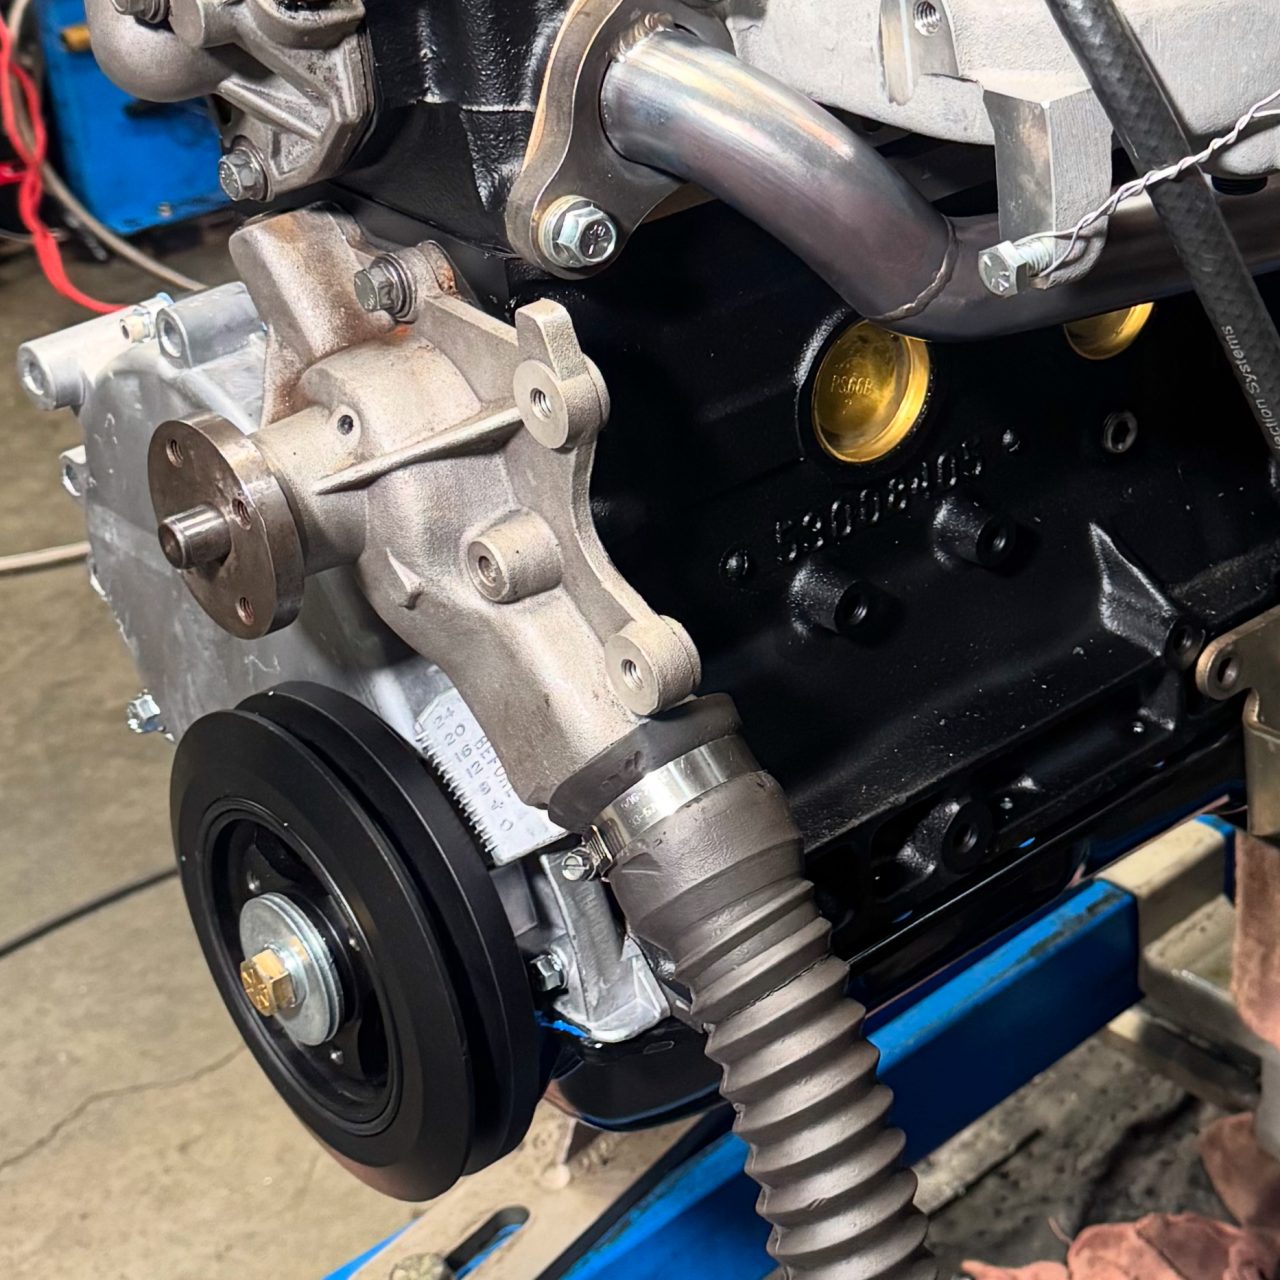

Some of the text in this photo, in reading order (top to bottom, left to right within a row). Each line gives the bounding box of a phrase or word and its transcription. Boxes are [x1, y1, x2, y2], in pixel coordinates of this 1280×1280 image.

[1221, 325, 1260, 394] Systems
[444, 723, 466, 747] 20
[454, 743, 473, 763] 16
[466, 760, 484, 779] 12
